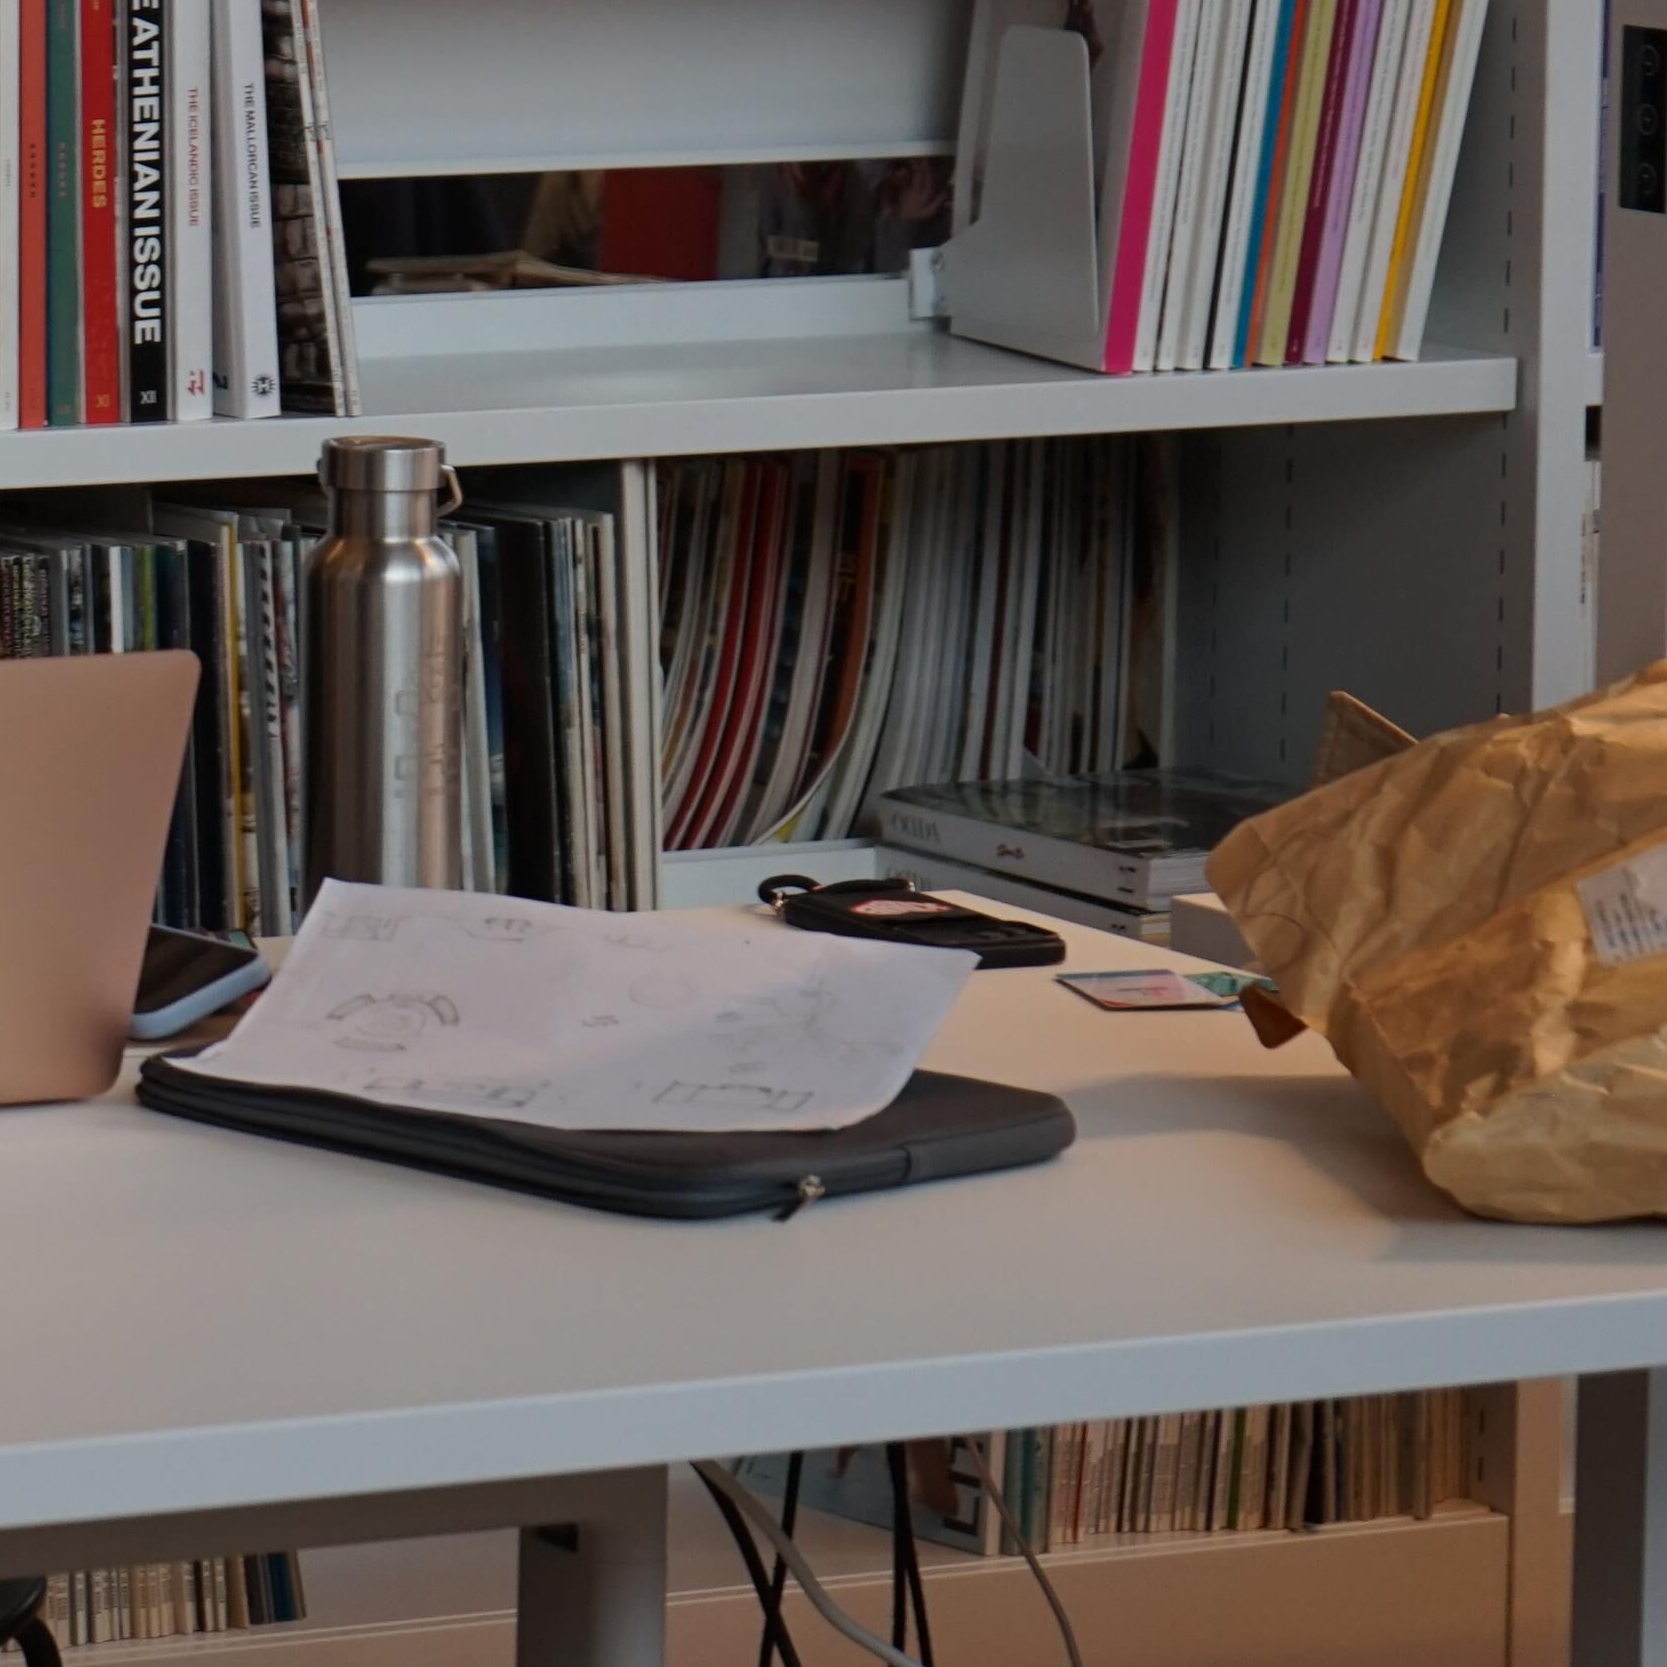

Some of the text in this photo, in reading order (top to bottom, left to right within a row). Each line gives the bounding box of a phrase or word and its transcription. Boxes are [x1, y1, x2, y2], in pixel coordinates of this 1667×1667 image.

[91, 119, 108, 208] HERDES
[131, 16, 162, 219] ATHENIAN
[188, 87, 199, 227] THE ICELANDIC ISSUE
[244, 83, 261, 229] THE MALLORCAN ISSUE
[133, 226, 162, 345] ISSUE
